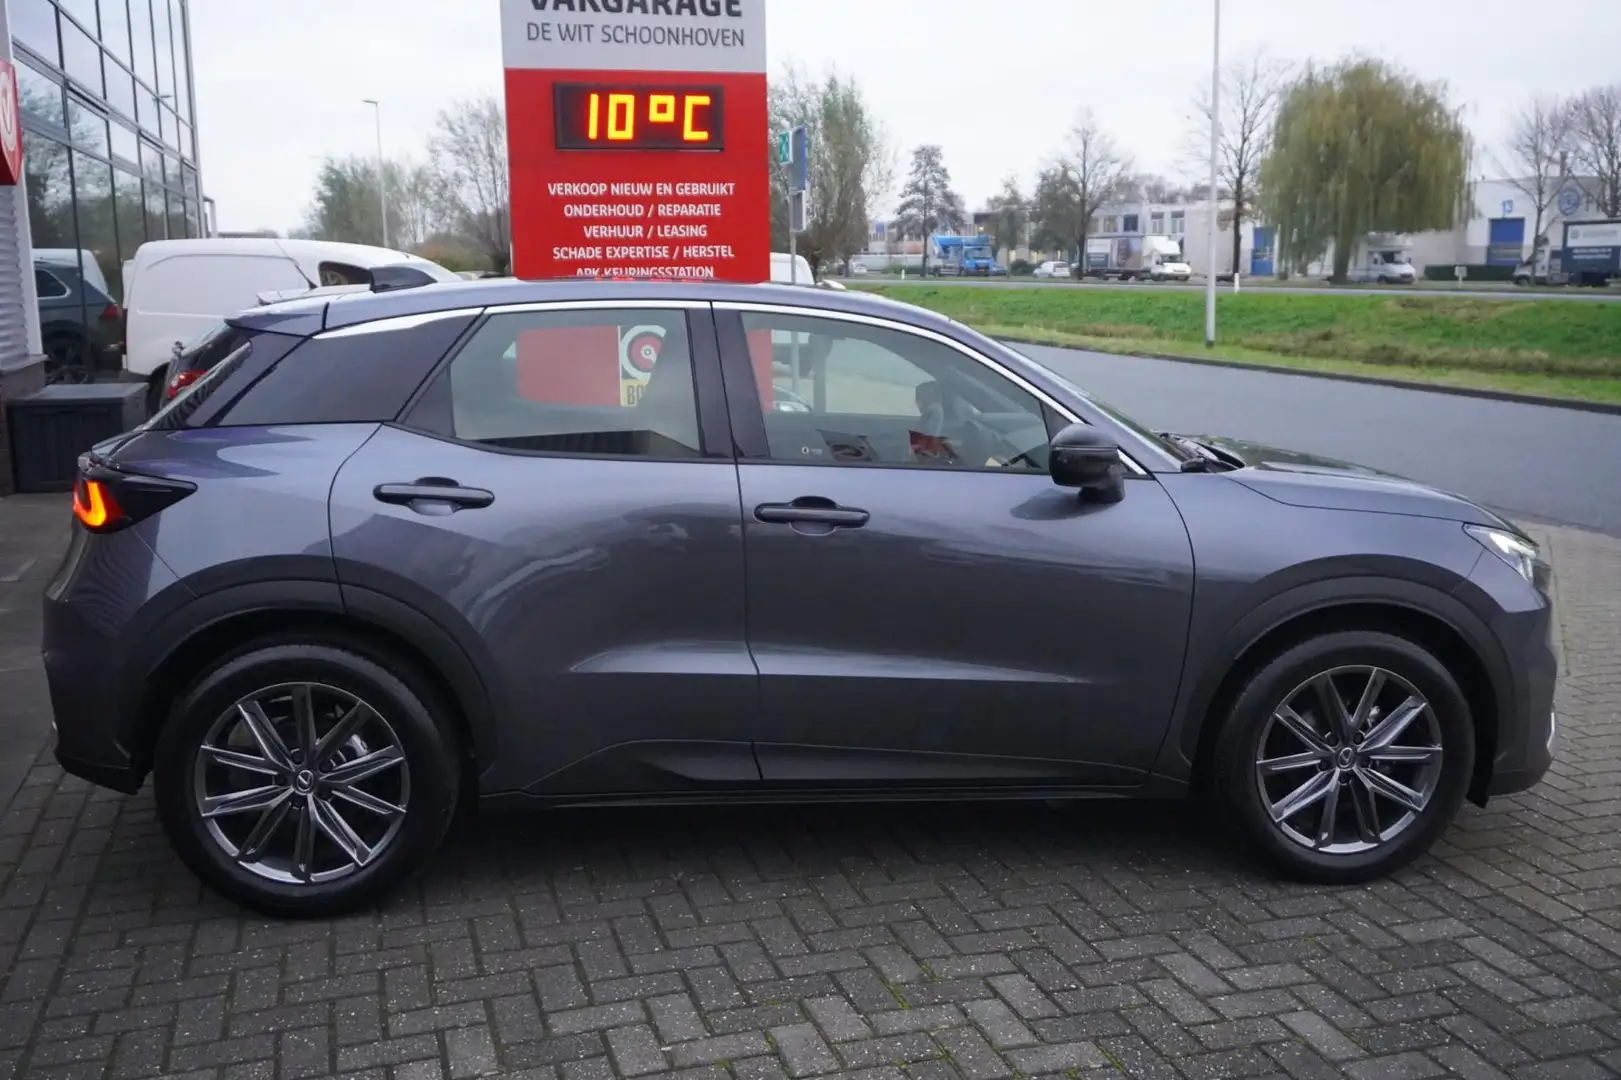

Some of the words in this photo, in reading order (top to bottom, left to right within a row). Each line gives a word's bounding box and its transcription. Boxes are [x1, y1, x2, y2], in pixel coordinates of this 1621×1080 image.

[527, 22, 552, 42] DE
[557, 23, 594, 42] WIT
[601, 25, 745, 47] SCHOONHOVEN
[548, 183, 607, 196] VERKOOP
[611, 183, 652, 196] NIEUW
[656, 183, 672, 195] EN
[675, 183, 735, 196] GEBRUIKT
[564, 204, 644, 217] ONDERHOUD
[647, 204, 654, 218] /
[657, 204, 721, 216] REPARATIE
[583, 225, 643, 238] VERHUUR
[647, 225, 654, 239] /
[657, 225, 707, 237] LEASING
[553, 247, 602, 259] SCHADE
[606, 246, 669, 259] EXPERTISE
[672, 246, 679, 260] /
[683, 245, 735, 258] HERSTEL
